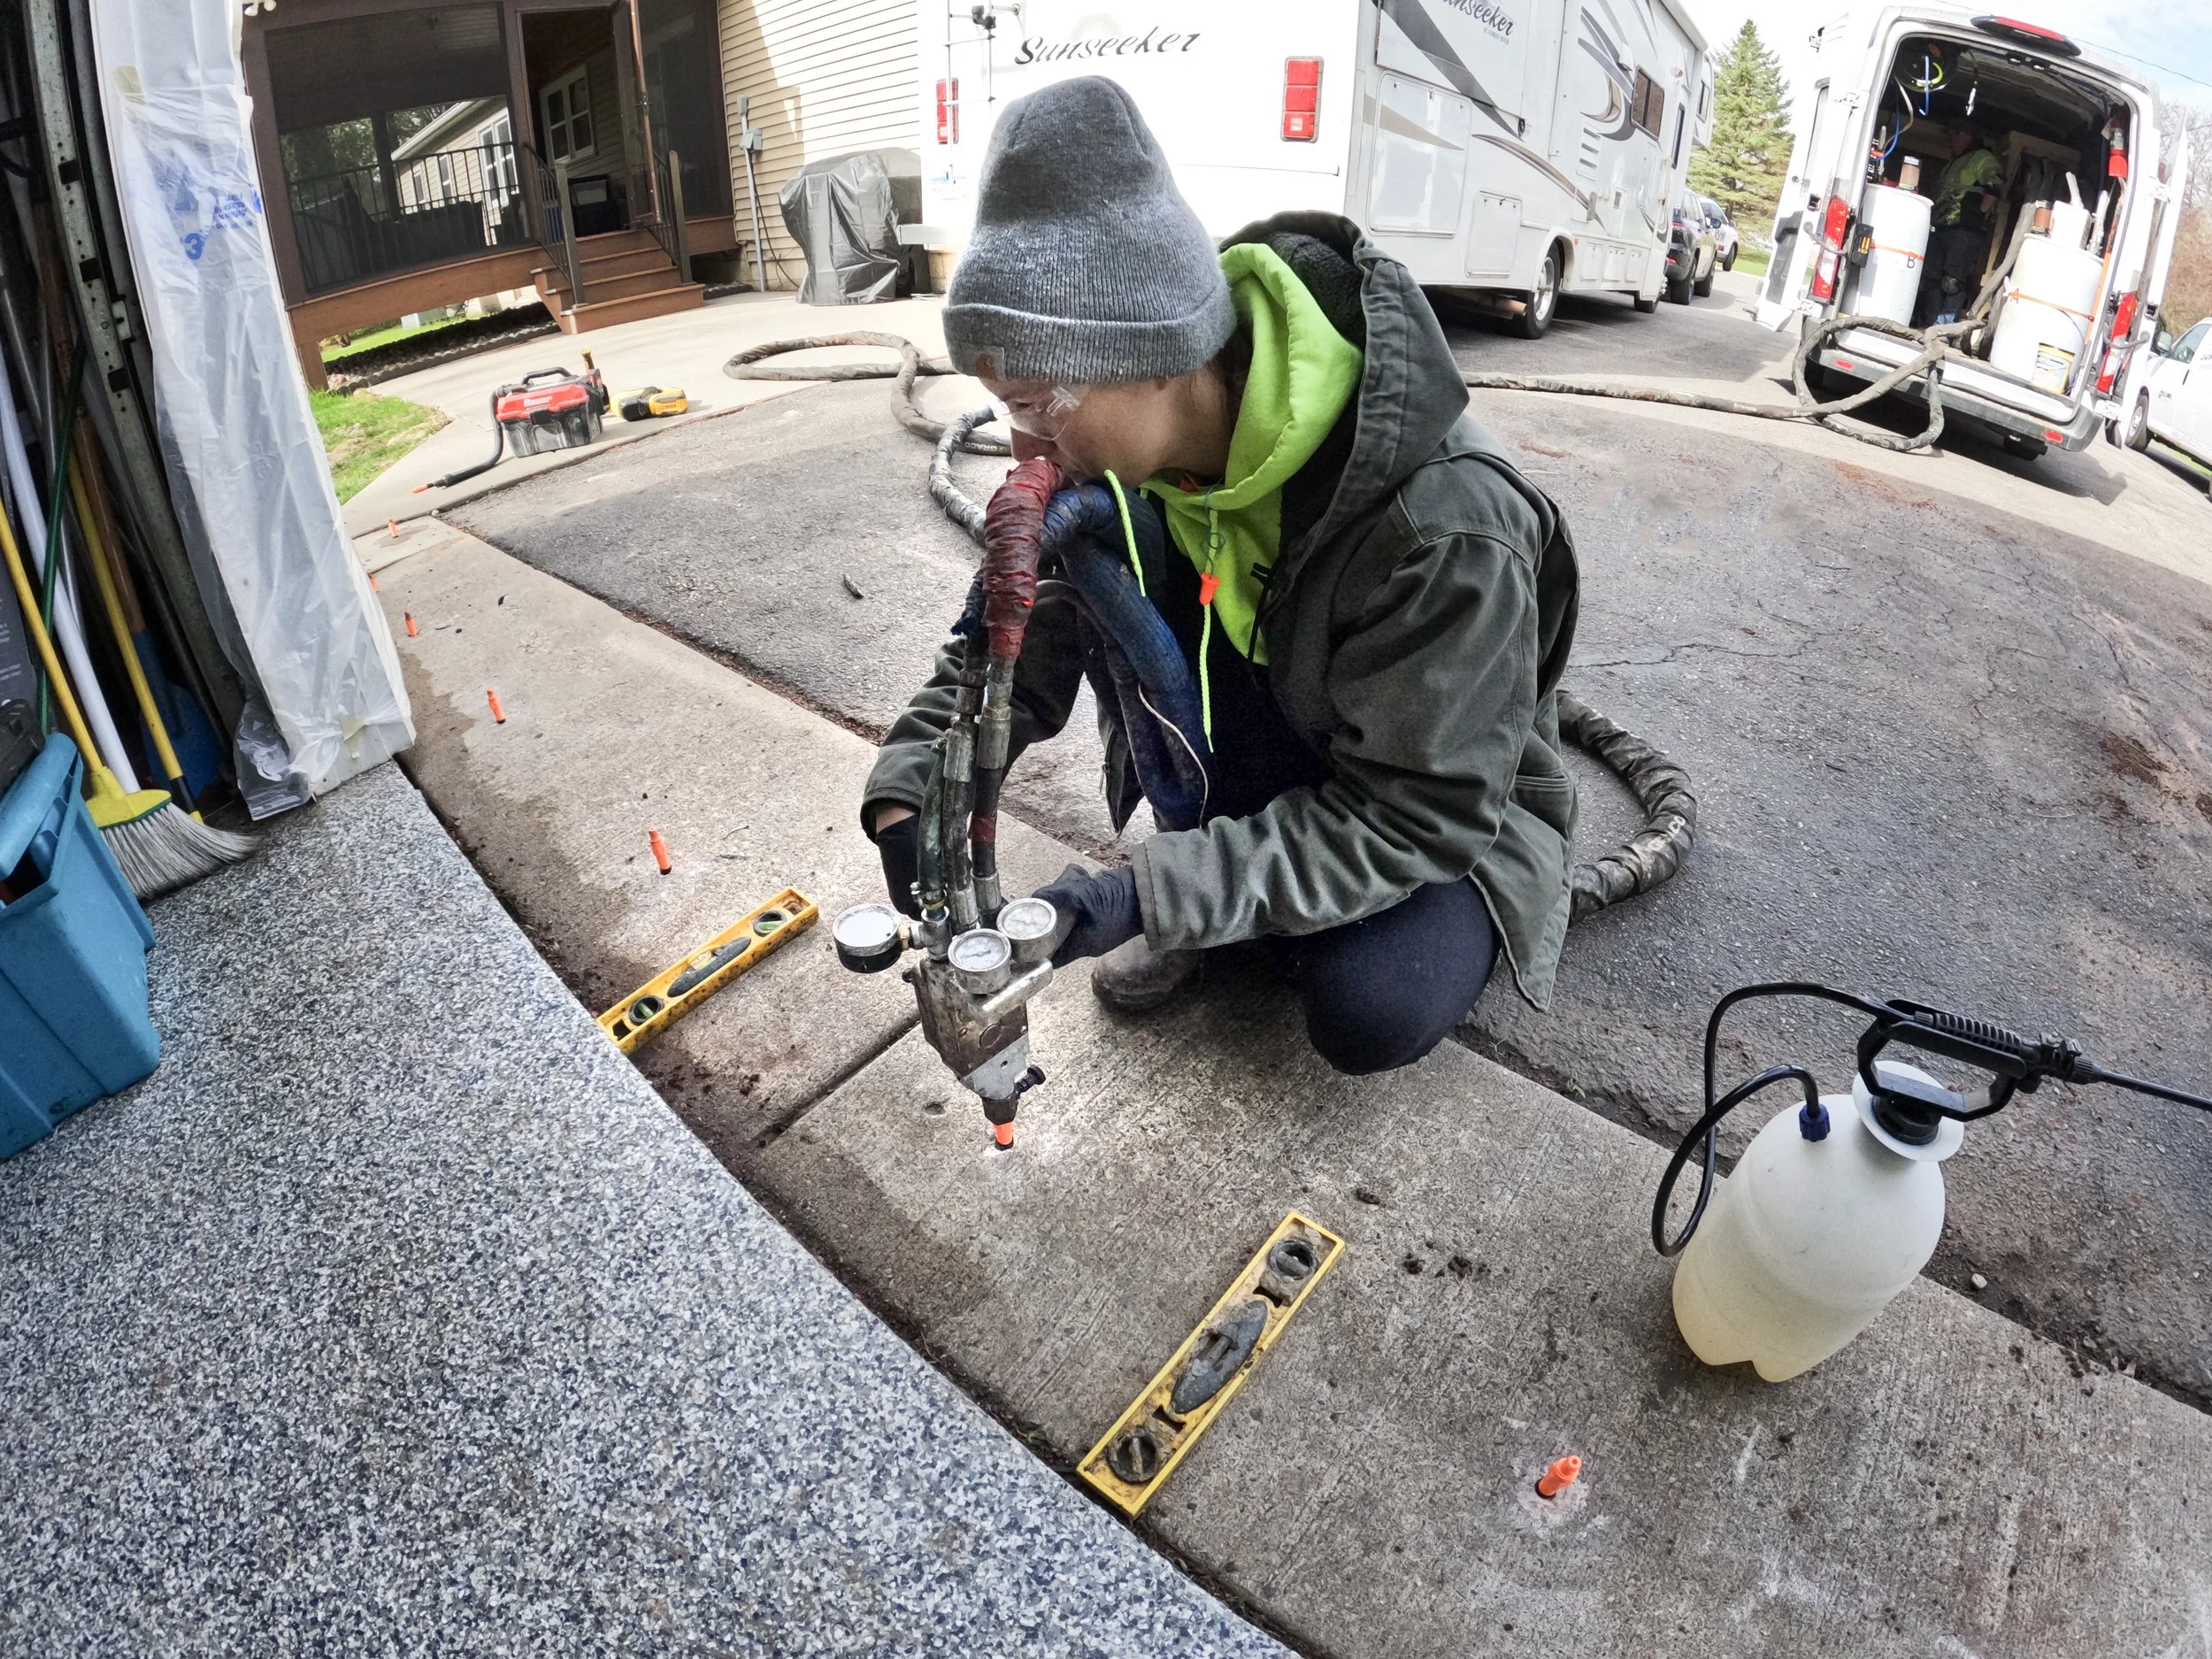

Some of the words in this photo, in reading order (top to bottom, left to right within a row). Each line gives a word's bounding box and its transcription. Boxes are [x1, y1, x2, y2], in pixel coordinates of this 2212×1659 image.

[1443, 0, 1514, 36] nseeker
[1014, 26, 1201, 65] Sunseeker
[964, 442, 998, 452] GRACO
